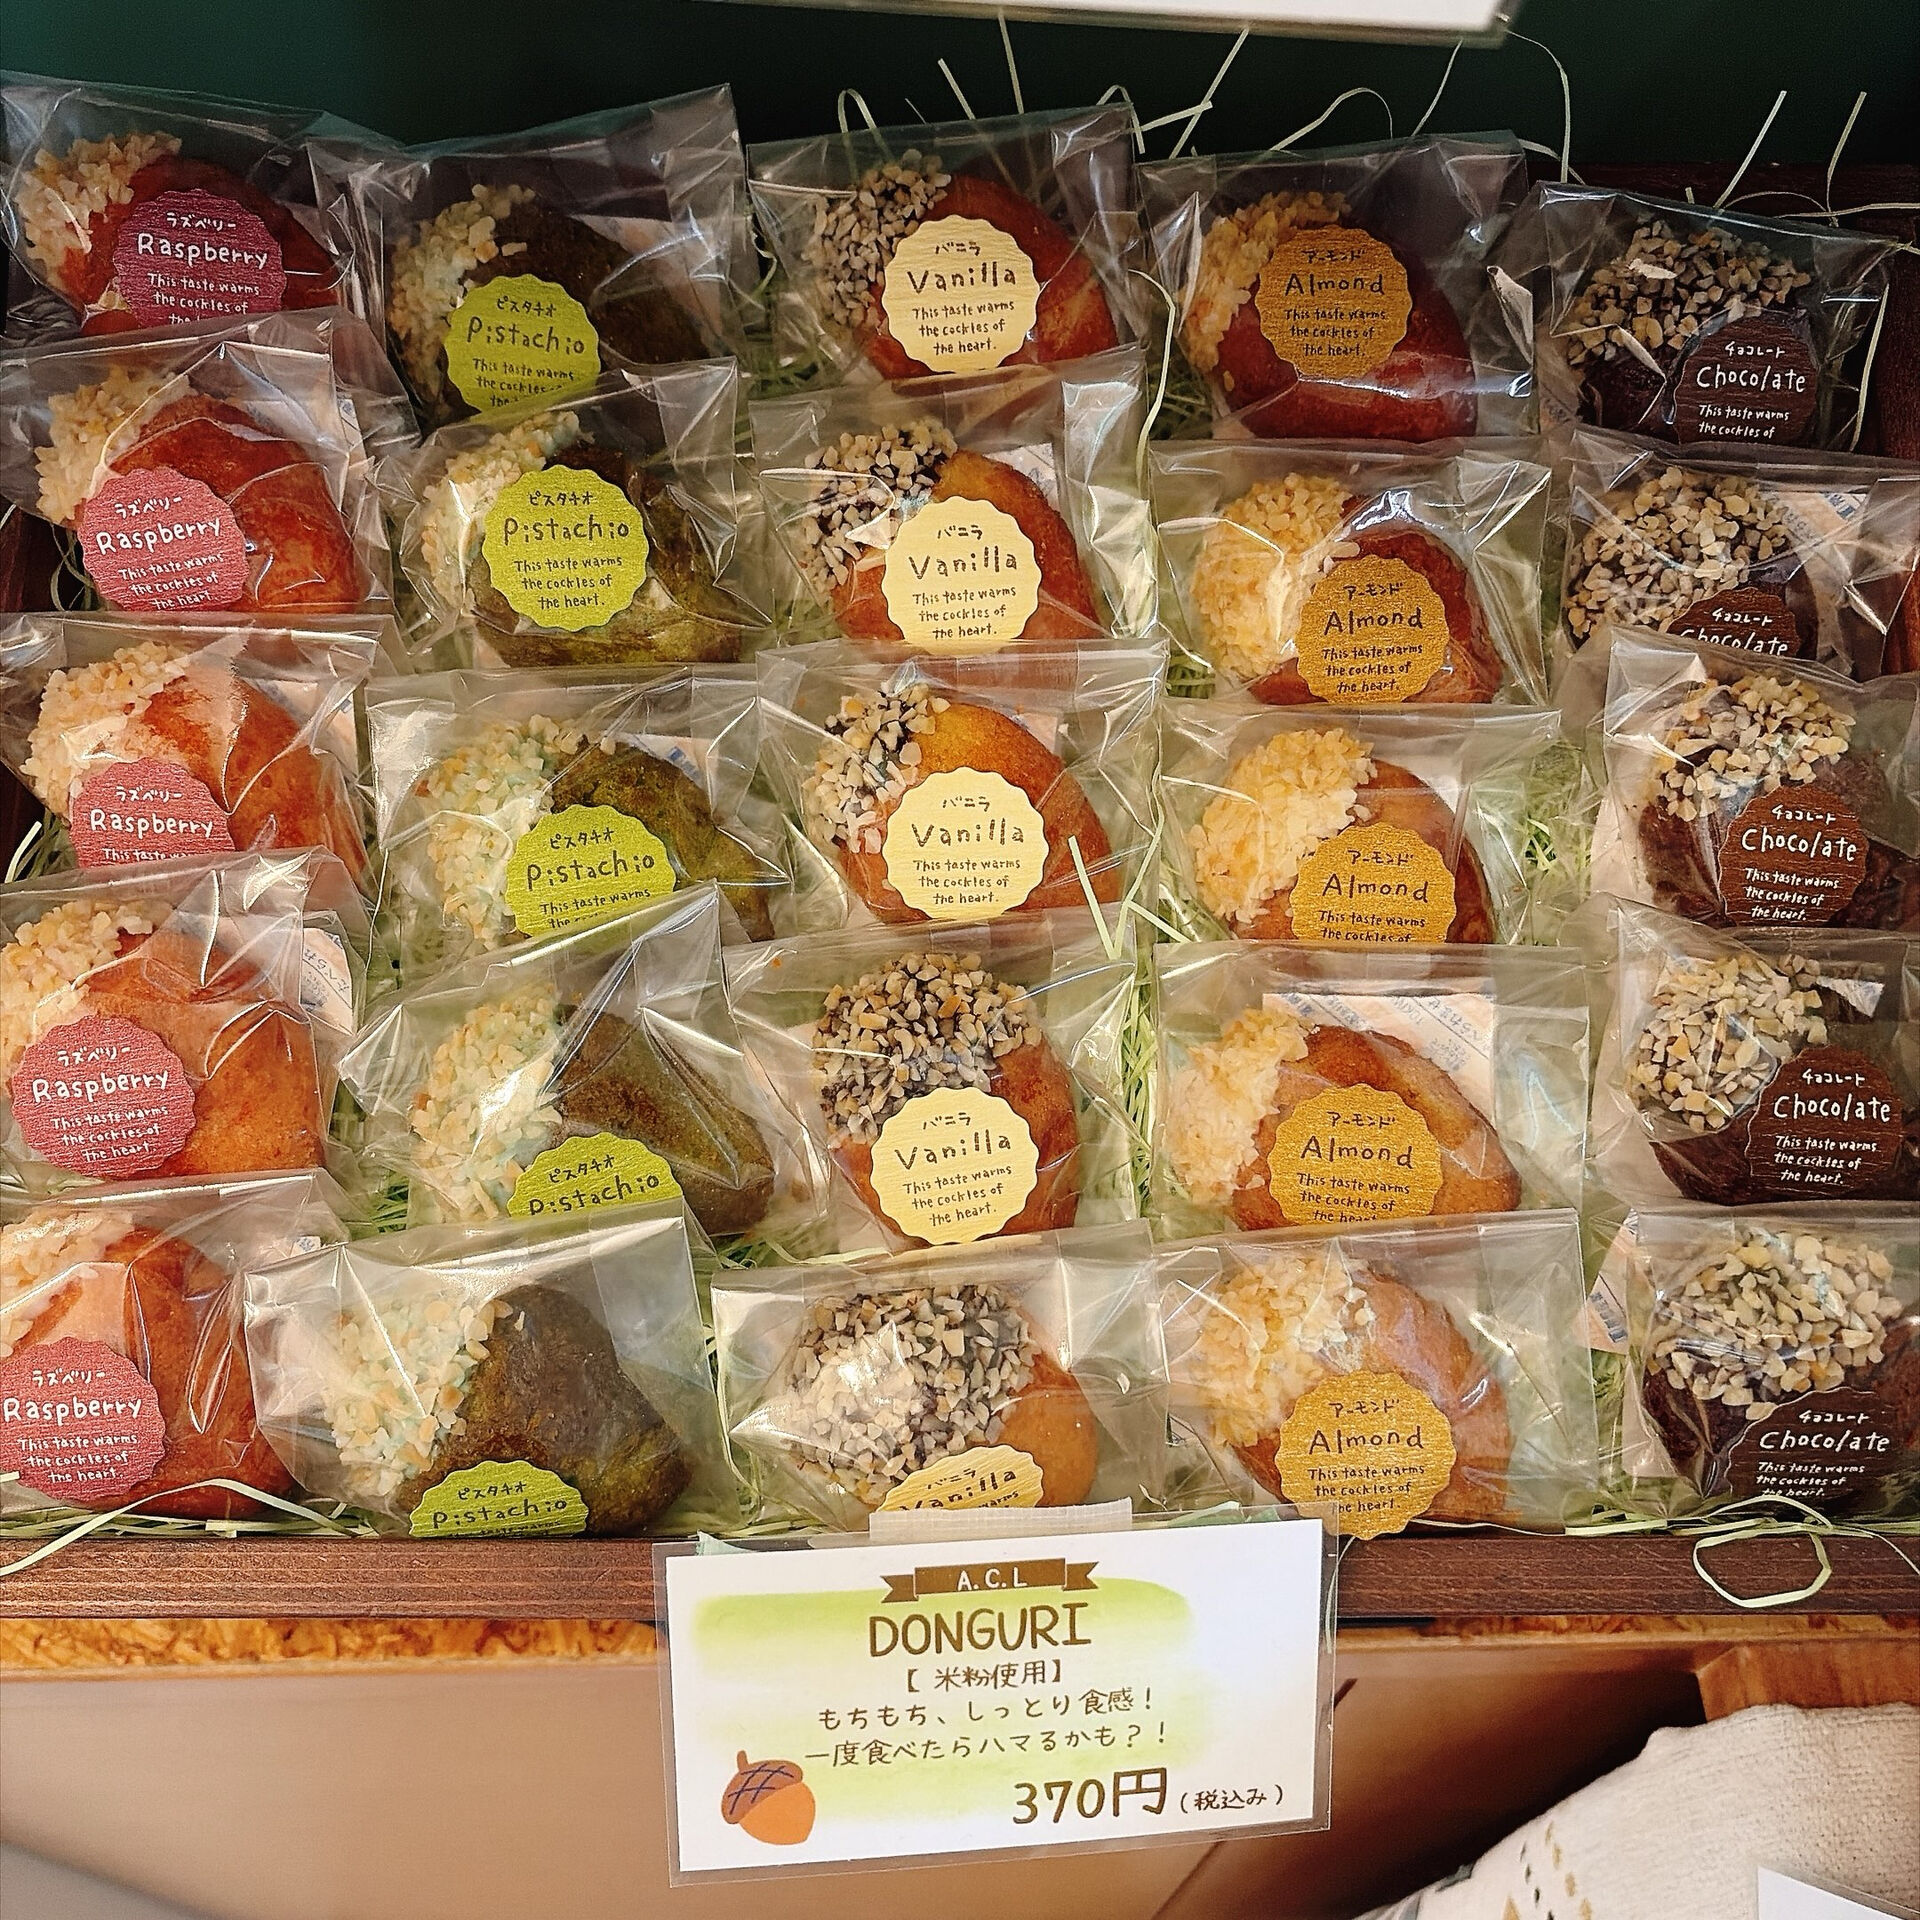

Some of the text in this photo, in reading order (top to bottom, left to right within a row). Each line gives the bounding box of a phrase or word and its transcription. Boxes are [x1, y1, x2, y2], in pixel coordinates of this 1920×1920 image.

[166, 212, 236, 231] ラズベリー
[137, 233, 267, 269] Raspberry
[935, 241, 981, 256] バニラ
[1302, 250, 1366, 263] アーモンド
[907, 261, 1016, 294] Vanilla
[1285, 273, 1384, 296] Almond
[497, 296, 556, 317] ピスタチオ
[912, 301, 1014, 320] This taste warms
[1285, 308, 1385, 320] This taste warms
[467, 316, 585, 355] Pistachio
[919, 319, 1005, 337] the cockles of
[933, 338, 997, 355] the heart.
[1725, 341, 1785, 358] チョコレート
[1697, 364, 1806, 392] Chocolate
[1699, 405, 1789, 420] This taste warms
[1699, 421, 1775, 438] the cockles of
[115, 497, 182, 518] ラズベリー
[530, 490, 592, 506] ピスタチオ
[96, 518, 220, 555] Raspberry
[505, 514, 629, 546] Pistachio
[937, 525, 983, 539] バニラ
[514, 557, 622, 573] This taste warms
[908, 545, 1017, 579] Vanilla
[522, 574, 612, 589] the cockles of
[1343, 582, 1403, 600] アーモンド
[538, 594, 604, 609] the heart.
[913, 587, 1016, 606] This taste warms
[919, 605, 1006, 622] the cockles of
[1324, 607, 1423, 635] Almond
[1712, 607, 1772, 626] チョコレート
[932, 623, 997, 639] the heart.
[115, 785, 182, 803] ラズベリー
[943, 795, 990, 812] バニラ
[89, 808, 213, 839] Raspberry
[1772, 804, 1836, 825] チョコレート
[550, 827, 614, 850] ピスタチオ
[911, 817, 1024, 847] Vanilla
[1742, 827, 1857, 862] Chocolate
[913, 858, 1021, 871] This taste warms
[1348, 850, 1413, 865] アーモンド
[527, 850, 655, 891] Pistachio
[1745, 868, 1839, 889] This taste warms
[919, 875, 1009, 888] the cockles of
[1322, 873, 1428, 903] Almond
[540, 888, 650, 915] This taste warms
[933, 892, 999, 904] the heart.
[1746, 886, 1824, 906] the cockles of
[1751, 905, 1807, 921] the heart.
[57, 1047, 130, 1066] ラズベリー
[32, 1070, 169, 1103] Raspberry
[1802, 1068, 1865, 1086] チョコレート
[1773, 1093, 1891, 1122] Chocolate
[51, 1106, 168, 1130] This taste warms
[923, 1112, 971, 1130] バニラ
[1327, 1111, 1396, 1129] アーモンド
[62, 1123, 161, 1146] the cockles of
[1775, 1136, 1877, 1151] This taste warms
[83, 1149, 107, 1162] the
[895, 1129, 1011, 1170] Vanilla
[1301, 1135, 1413, 1169] Almond
[550, 1155, 615, 1183] ピスタチオ
[1774, 1153, 1862, 1169] the cockles of
[903, 1165, 1012, 1194] This taste warms
[1297, 1173, 1409, 1195] This taste warms
[1781, 1170, 1844, 1184] the heart.
[912, 1183, 1004, 1209] the cockles of
[929, 1202, 996, 1226] the heart.
[32, 1368, 106, 1387] ラズベリー
[3, 1396, 141, 1426] Raspberry
[1329, 1400, 1399, 1418] アーモンド
[1799, 1410, 1869, 1424] チョコレート
[18, 1435, 137, 1451] This taste warms
[1309, 1426, 1423, 1454] Almond
[1760, 1429, 1890, 1452] Chocolate
[27, 1451, 128, 1467] the cockles of
[48, 1472, 72, 1483] the
[1308, 1466, 1424, 1480] This taste warms
[458, 1481, 526, 1500] ピスタチオ
[1315, 1482, 1411, 1496] the cockles of
[433, 1499, 567, 1528] Pistachio
[956, 1567, 1027, 1592] A.C.L
[869, 1602, 1091, 1657] DONGURI
[1013, 1767, 1167, 1824] 370円
